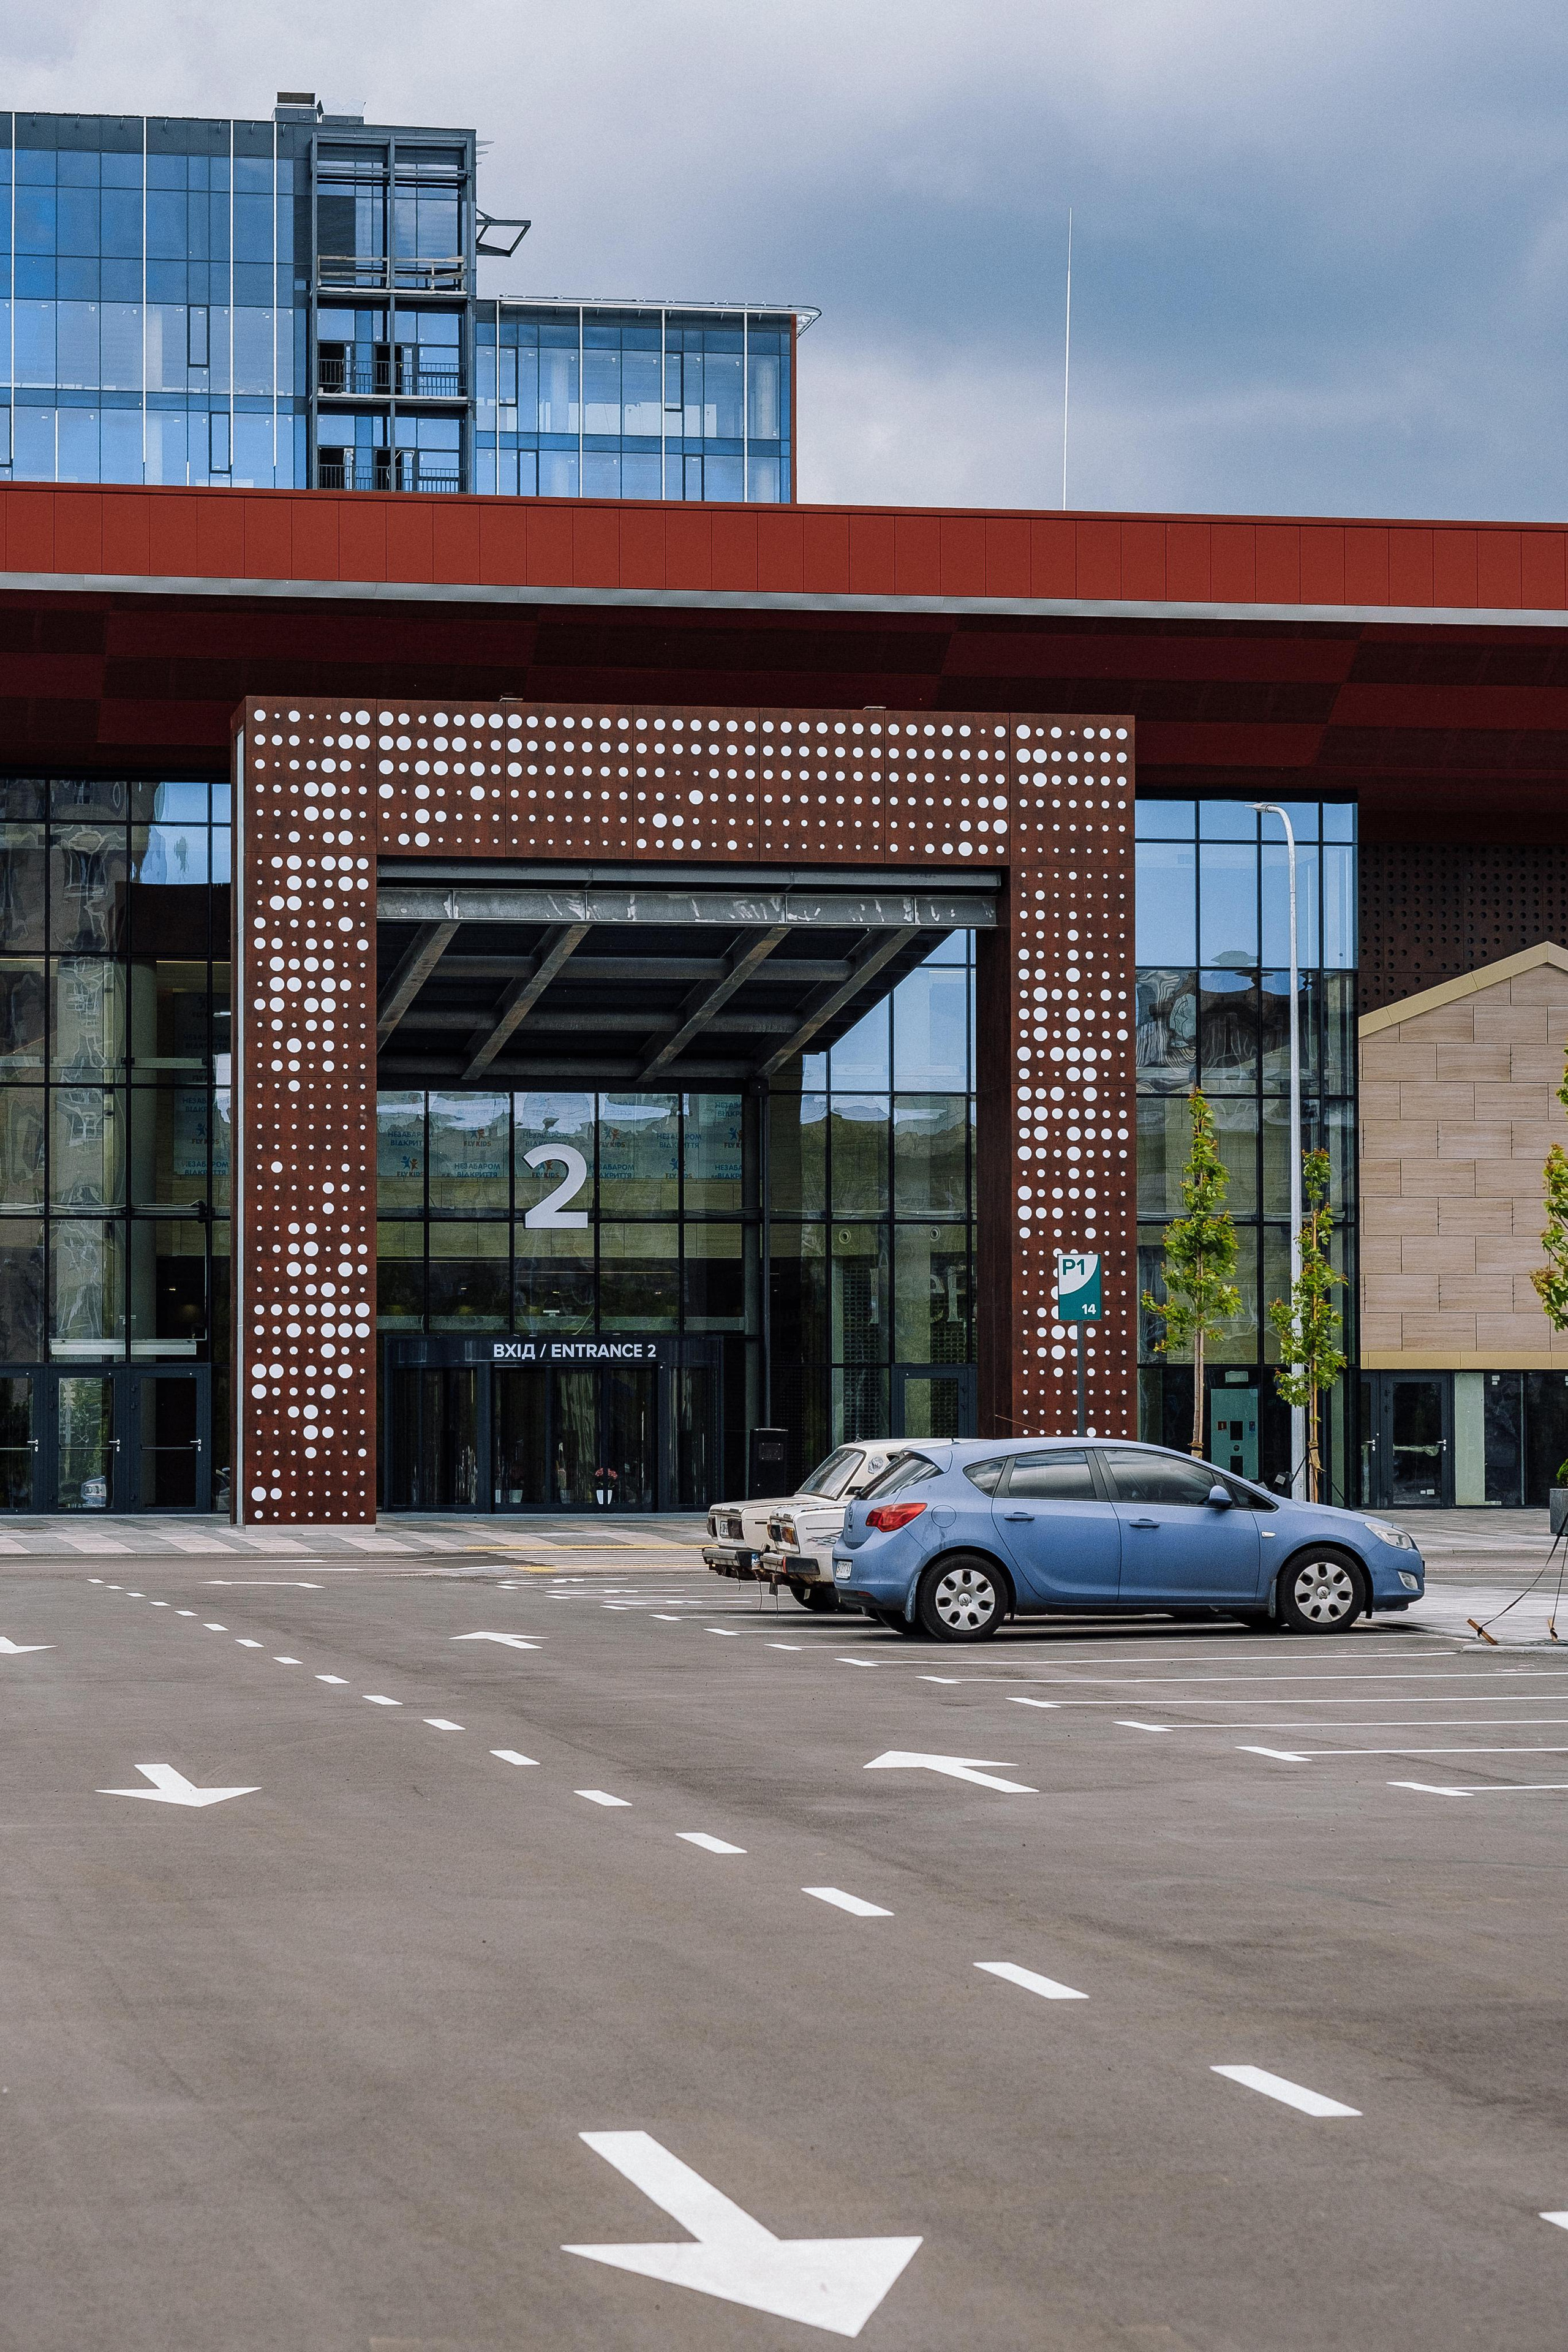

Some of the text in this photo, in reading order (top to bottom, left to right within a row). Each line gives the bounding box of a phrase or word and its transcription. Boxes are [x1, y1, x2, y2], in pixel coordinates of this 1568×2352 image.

[523, 1143, 588, 1229] 2
[1062, 1259, 1085, 1276] P1
[1082, 1303, 1096, 1315] 14
[493, 1343, 536, 1360] ВХІД
[551, 1343, 643, 1358] ENTRANCE
[647, 1344, 657, 1358] 2
